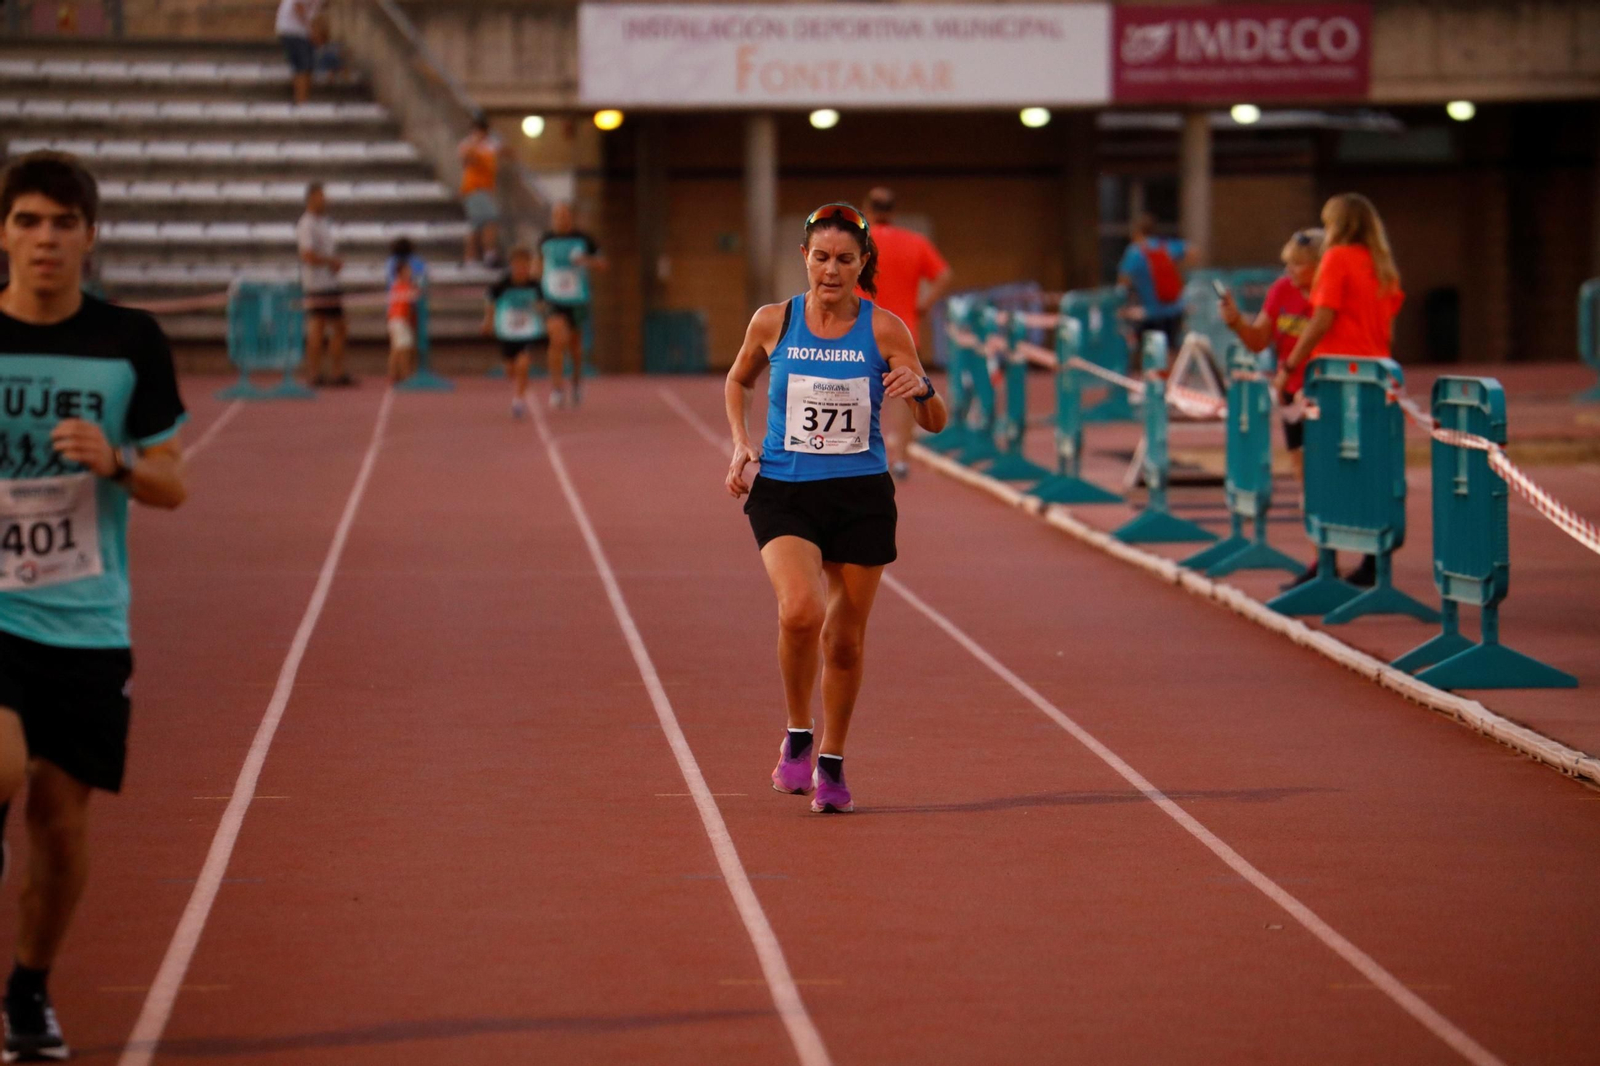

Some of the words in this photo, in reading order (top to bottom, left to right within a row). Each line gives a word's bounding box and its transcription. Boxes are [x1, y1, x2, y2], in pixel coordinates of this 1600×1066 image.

[794, 15, 925, 40] DEPORTIVA
[932, 15, 1067, 40] MUNICIPAL
[1175, 16, 1361, 63] IMDECO
[786, 346, 866, 363] TROTASIERRA
[802, 406, 856, 433] 371
[1, 516, 75, 557] 401
